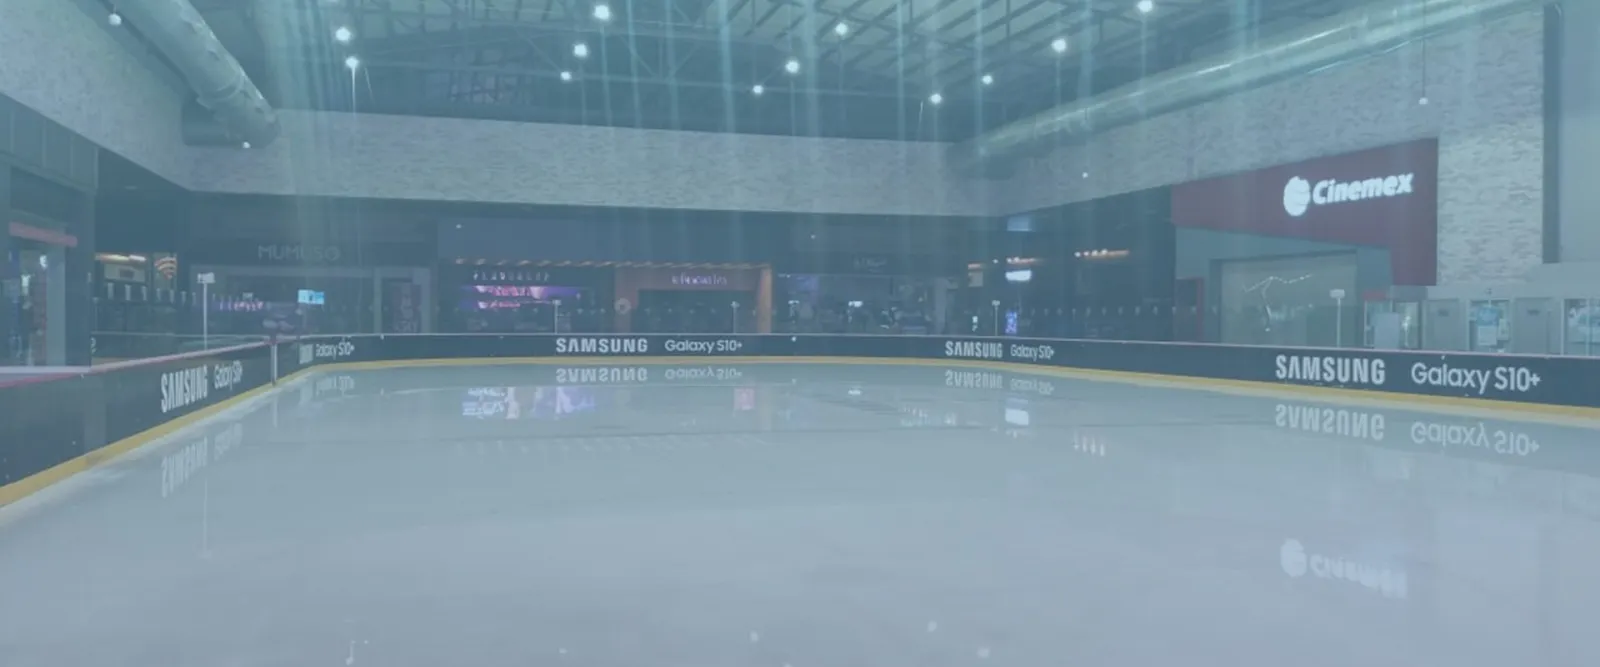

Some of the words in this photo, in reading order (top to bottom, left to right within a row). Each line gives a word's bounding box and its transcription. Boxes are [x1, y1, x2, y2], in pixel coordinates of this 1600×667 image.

[1312, 172, 1414, 205] Cinemex
[258, 244, 341, 261] MUMUSO
[556, 338, 648, 353] SAMSUNG
[664, 339, 714, 354] Galaxy
[717, 340, 743, 352] S10+
[945, 341, 1004, 358] SAMSUNG
[1010, 344, 1038, 361] Galaxy
[1275, 354, 1386, 385] SAMSUNG
[1411, 362, 1490, 394] Galaxy
[1495, 366, 1541, 391] S10+
[161, 364, 208, 413] SAMSUNG
